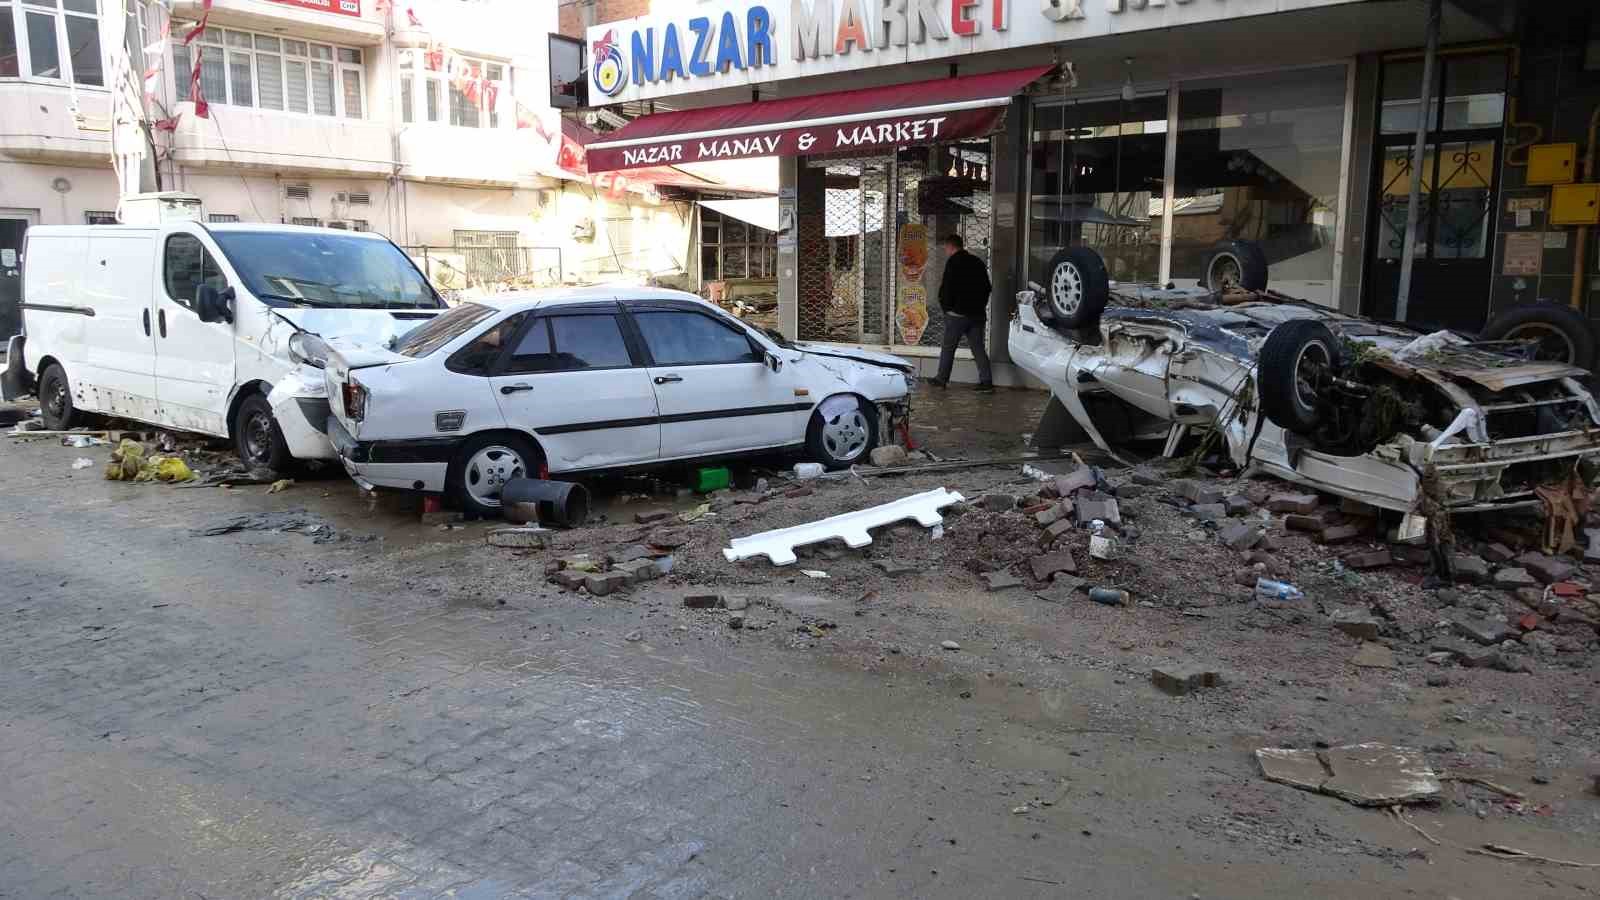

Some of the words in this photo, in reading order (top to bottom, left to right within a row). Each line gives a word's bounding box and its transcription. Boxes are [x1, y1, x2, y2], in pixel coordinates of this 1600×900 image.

[631, 6, 775, 86] NAZAR
[623, 144, 682, 165] NAZAR
[698, 134, 781, 158] MANAV
[798, 132, 816, 150] &
[836, 117, 946, 147] MARKET
